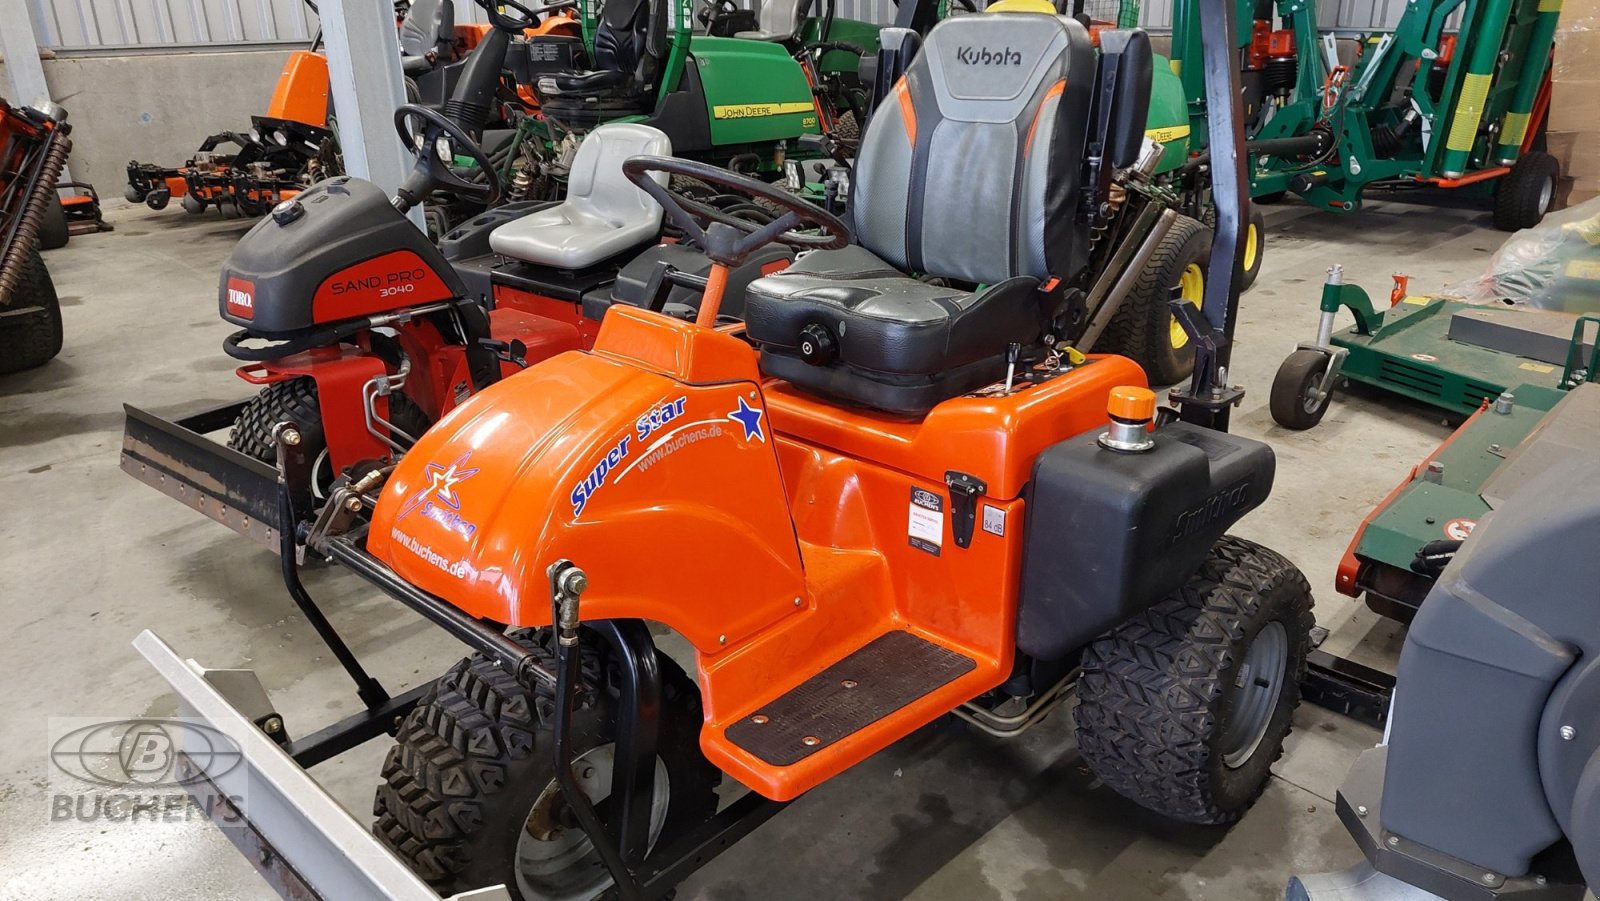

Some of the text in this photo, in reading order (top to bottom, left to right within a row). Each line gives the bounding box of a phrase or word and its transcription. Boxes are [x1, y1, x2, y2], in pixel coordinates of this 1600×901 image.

[957, 46, 1022, 65] Kubota
[722, 106, 772, 118] JOHN DEERE
[331, 268, 425, 295] SAND PRO
[380, 283, 414, 298] 3040
[228, 288, 252, 307] TORO
[570, 396, 688, 518] Super Star
[637, 425, 723, 473] www.buchens.de
[984, 519, 1003, 533] 84 dB
[391, 527, 465, 578] www.buchens.de
